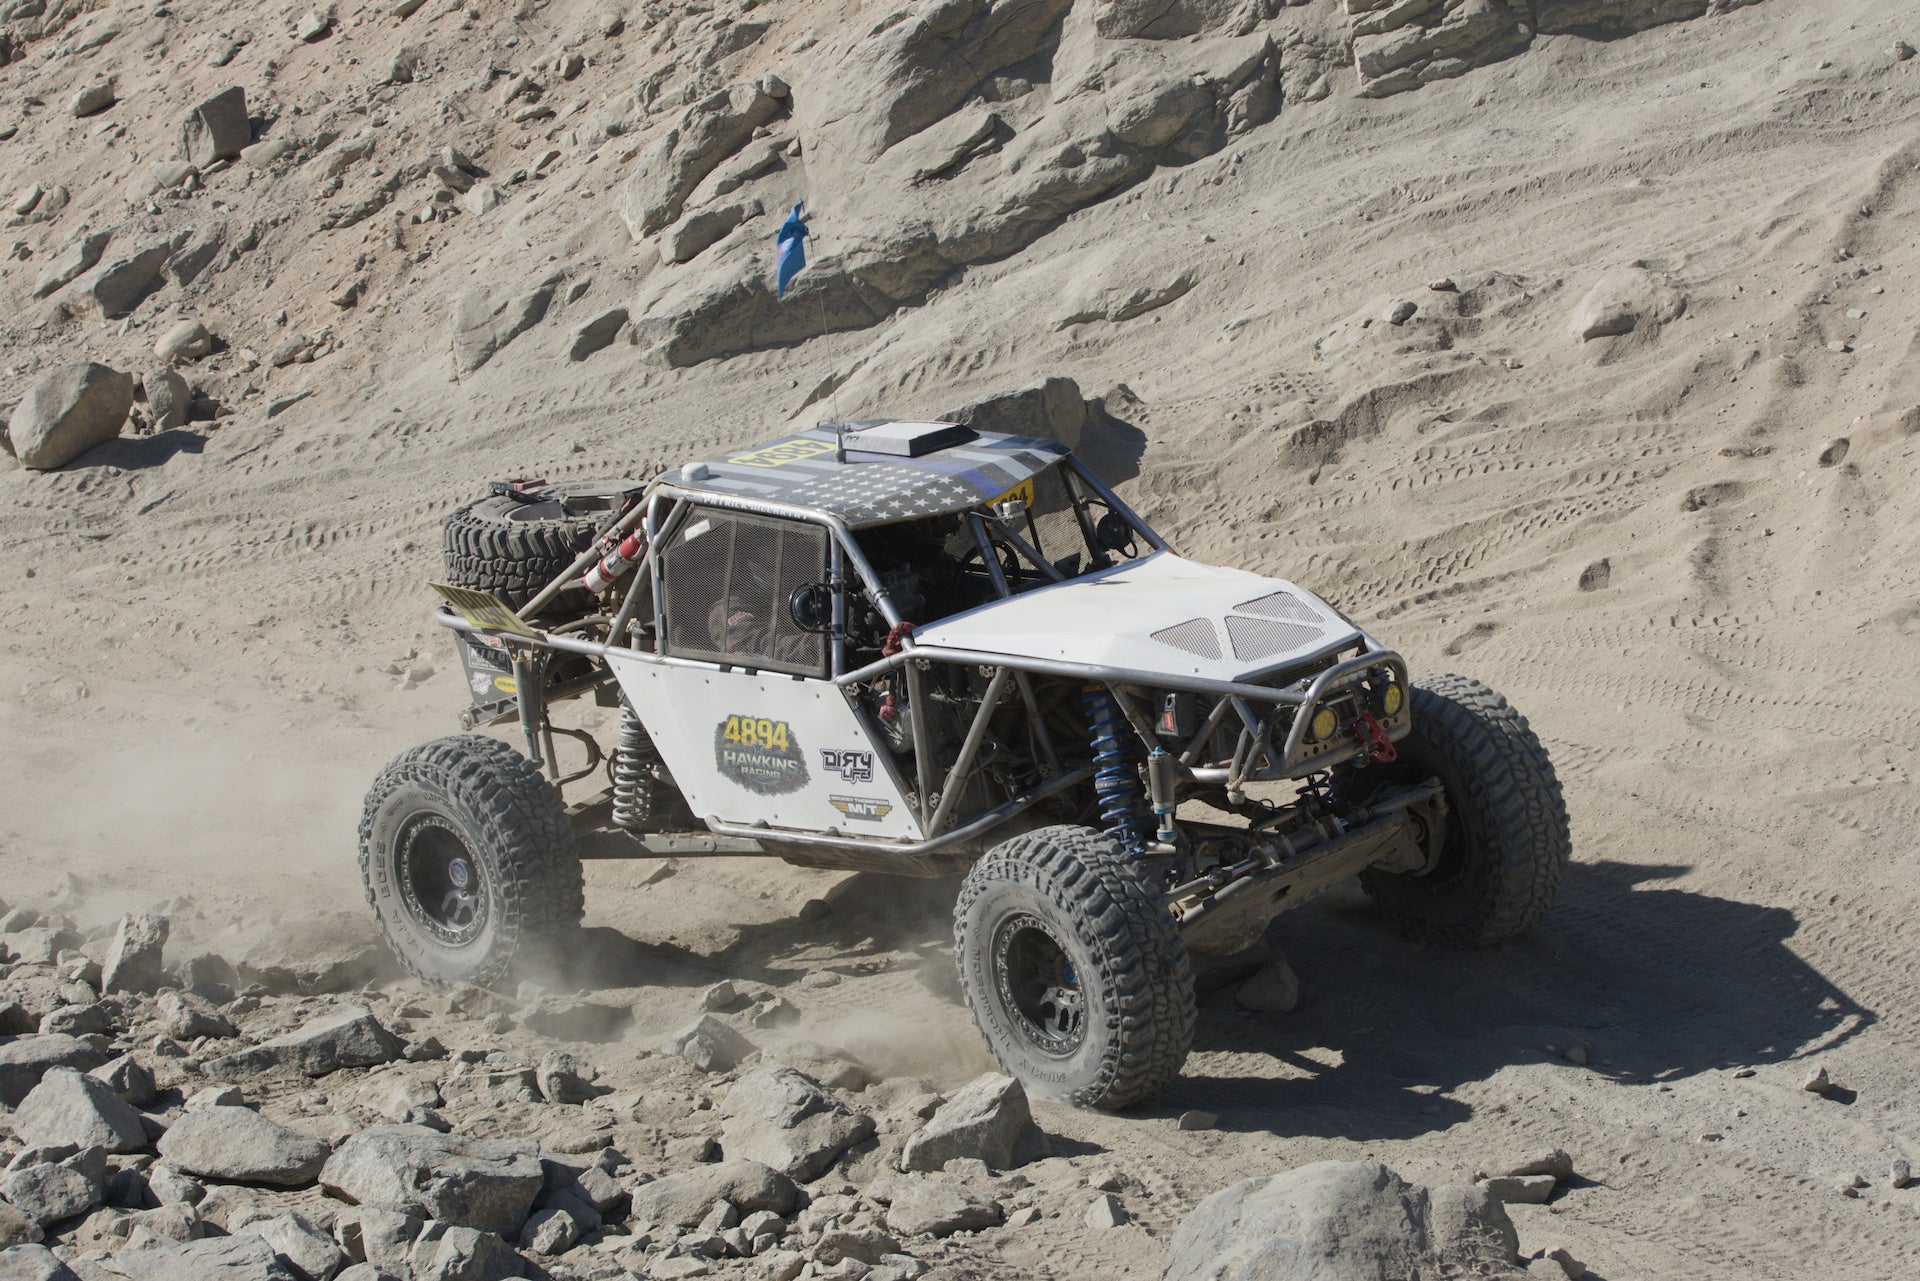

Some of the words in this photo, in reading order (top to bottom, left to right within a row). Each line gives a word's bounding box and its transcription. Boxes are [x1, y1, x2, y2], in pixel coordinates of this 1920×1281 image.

[723, 715, 789, 752] 4894
[723, 750, 798, 772] HAWKINS
[741, 766, 781, 779] RACING
[843, 768, 871, 781] LIFE
[848, 803, 877, 815] M/T
